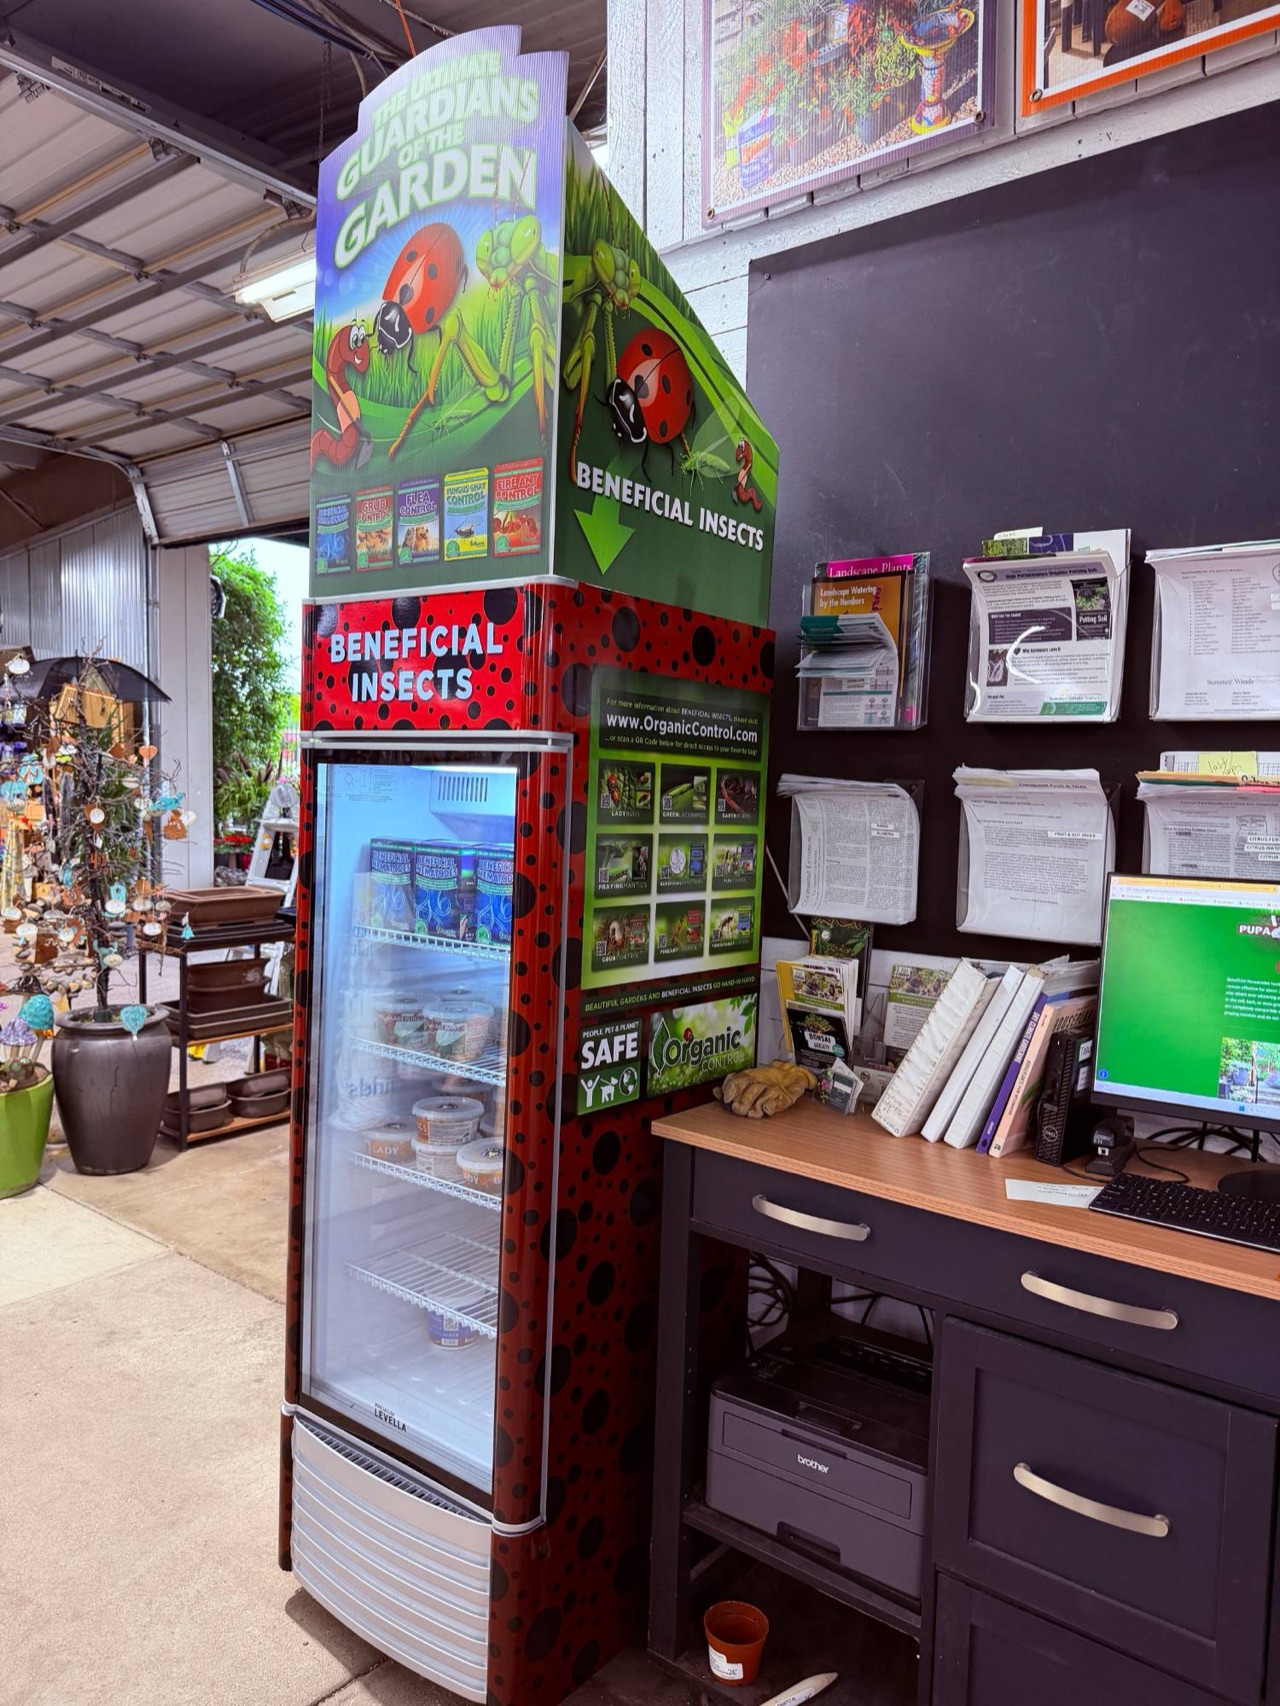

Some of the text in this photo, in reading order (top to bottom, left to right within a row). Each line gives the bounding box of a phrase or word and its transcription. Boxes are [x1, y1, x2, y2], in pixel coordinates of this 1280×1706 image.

[373, 50, 502, 129] THE ULTIMATE
[336, 77, 539, 200] GUARDIANS
[399, 123, 465, 169] OF THE
[333, 143, 538, 269] GARDEN
[446, 482, 487, 495] FUNGUS GNAT
[497, 473, 539, 491] FIRE ANT
[406, 490, 430, 505] FLEA
[446, 490, 486, 505] CONTROL
[495, 486, 539, 500] CONTROL
[362, 498, 386, 511] GRUB
[400, 503, 437, 516] CONTROL
[577, 461, 764, 551] BENEFICIAL INSECTS
[356, 512, 391, 522] CONTROL
[820, 585, 877, 597] Landscape Watering
[820, 597, 864, 608] by the Numbers
[1080, 615, 1107, 625] Potting Soil
[331, 622, 503, 663] BENEFICIAL
[352, 669, 473, 702] INSECTS
[618, 700, 632, 708] more
[634, 702, 664, 712] information
[665, 706, 680, 714] about
[681, 708, 710, 718] BENEFICIAL
[607, 714, 758, 743] www.OrganicControl.com
[684, 741, 698, 749] direct
[730, 746, 747, 754] favorite
[373, 850, 410, 863] BENEFICIAL
[417, 855, 457, 867] BENEFICIAL
[372, 859, 411, 874] NEMATODES
[416, 864, 457, 879] NEMATODES
[1239, 925, 1270, 935] PUPA
[585, 998, 618, 1012] BEAUTIFUL
[620, 993, 648, 1005] GARDENS
[648, 993, 661, 1001] AND
[661, 986, 691, 998] BENEFICIAL
[692, 983, 712, 992] INSECTS
[722, 976, 755, 988] HAND-IN-HAND
[605, 1027, 614, 1035] PET
[620, 1021, 639, 1032] PLANET
[809, 1033, 832, 1043] BONSAI
[581, 1031, 639, 1070] SAFE
[663, 1026, 741, 1067] Organic
[701, 1051, 745, 1073] CONTROL
[372, 1145, 399, 1155] LADY
[374, 1409, 407, 1433] LEVELLA
[797, 1454, 829, 1474] brother
